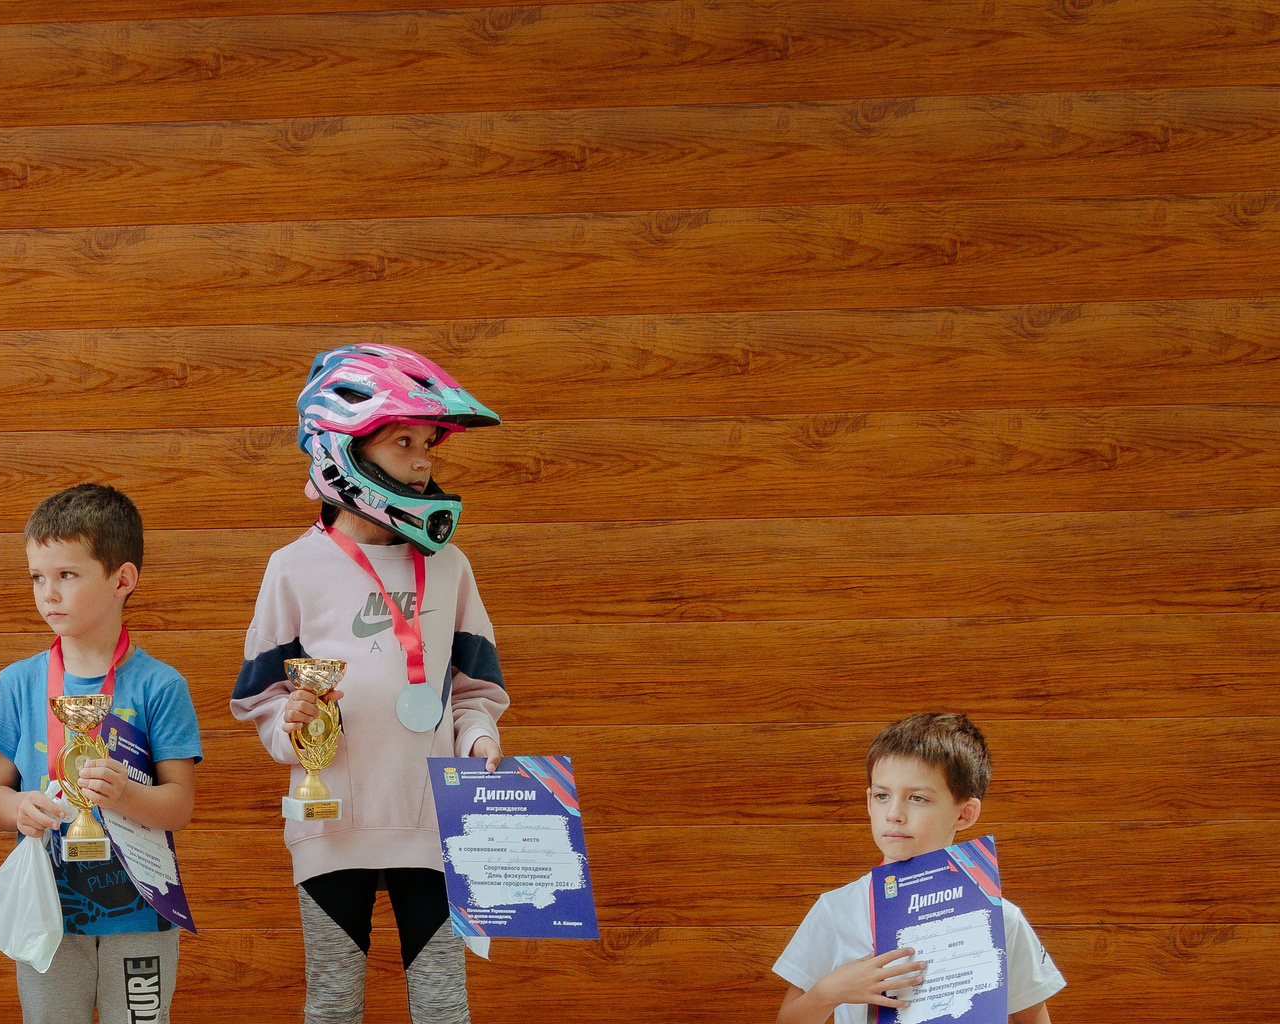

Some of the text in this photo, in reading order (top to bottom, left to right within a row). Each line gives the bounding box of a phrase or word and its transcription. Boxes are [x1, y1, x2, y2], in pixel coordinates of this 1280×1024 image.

[474, 787, 536, 803] Диплом
[908, 884, 963, 914] Диплом
[918, 908, 954, 921] награждается
[945, 970, 973, 981] праздника
[912, 977, 973, 996] "День физкультурника"
[927, 990, 954, 1000] городском
